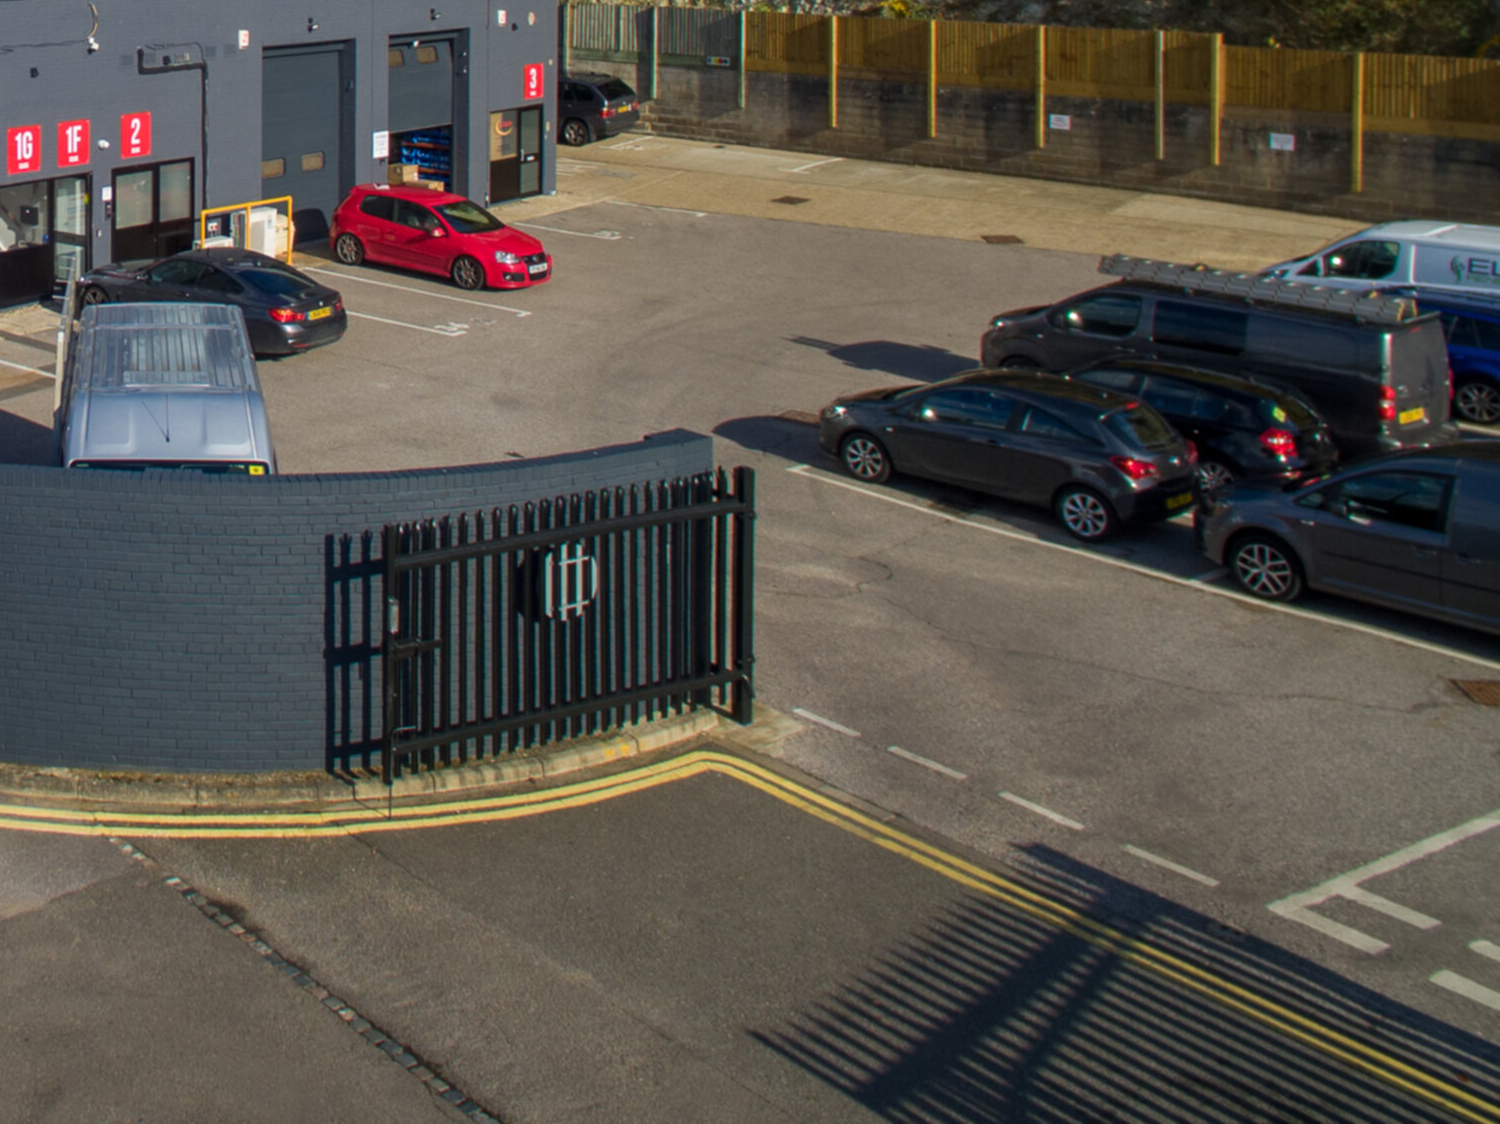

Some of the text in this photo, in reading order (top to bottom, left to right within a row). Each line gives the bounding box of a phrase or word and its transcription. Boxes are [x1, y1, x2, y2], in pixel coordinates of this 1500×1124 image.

[530, 68, 536, 89] 3
[15, 131, 33, 160] 1G
[66, 125, 82, 154] 1F
[131, 118, 141, 145] 2
